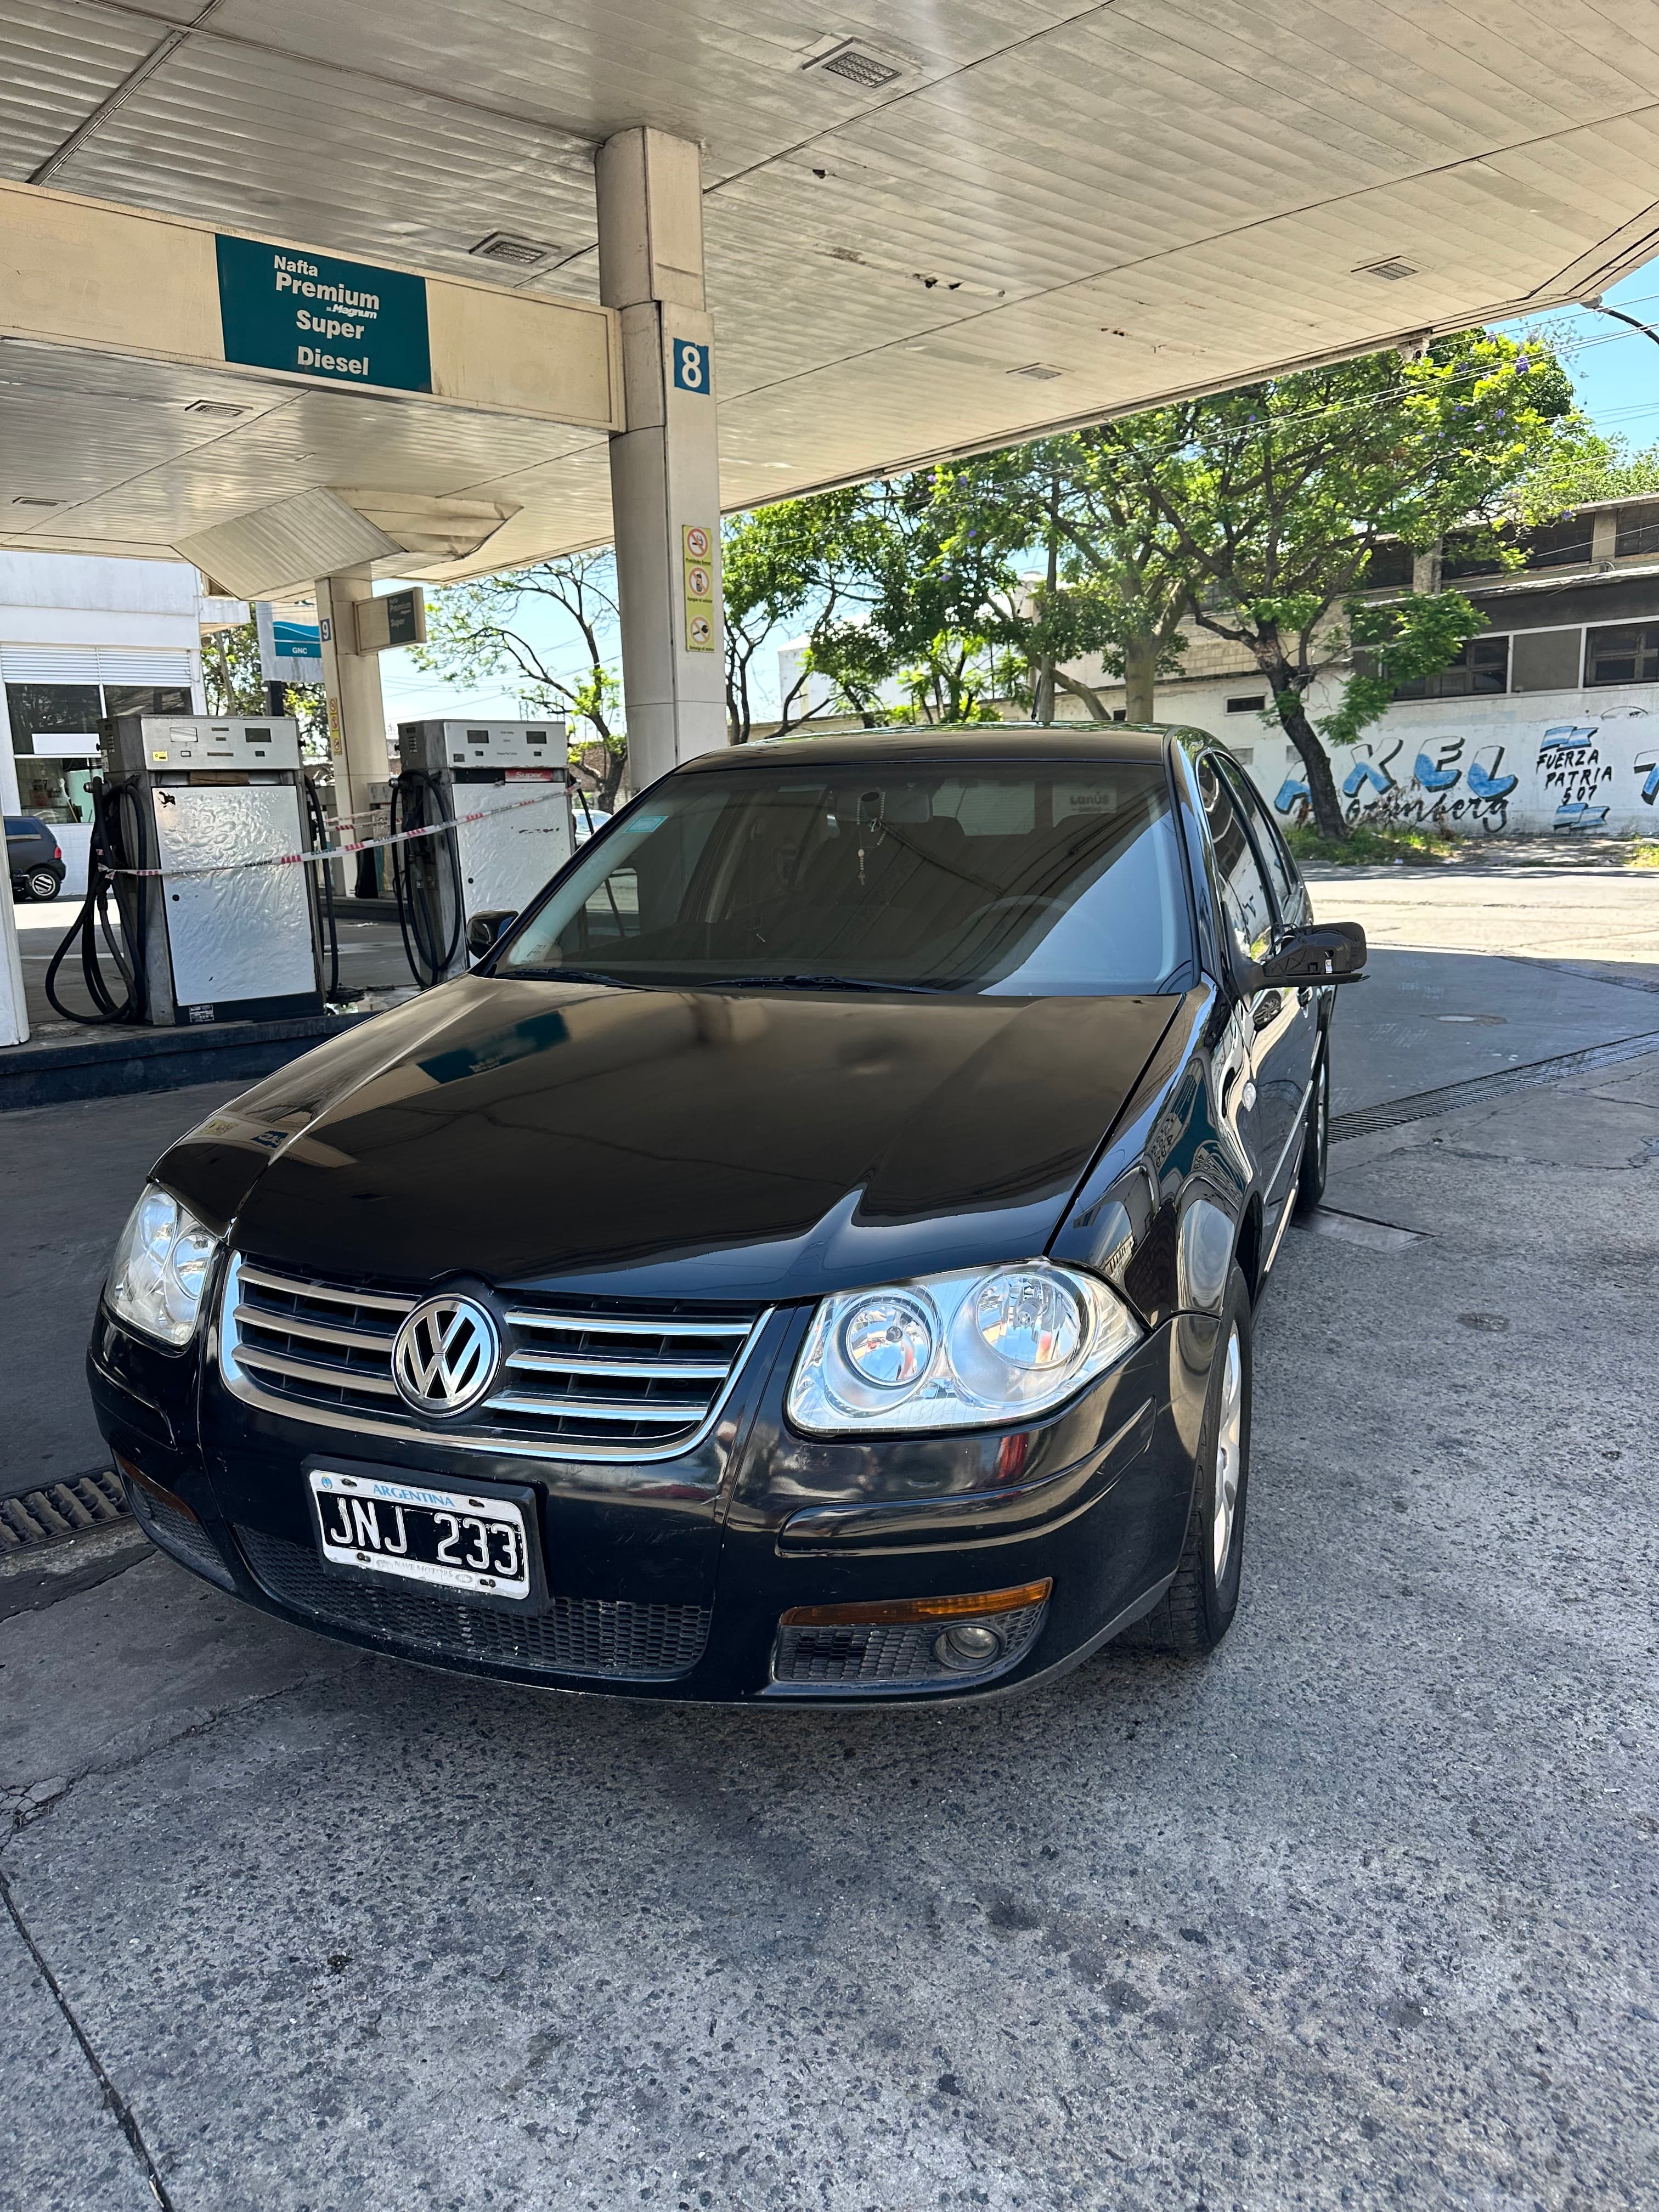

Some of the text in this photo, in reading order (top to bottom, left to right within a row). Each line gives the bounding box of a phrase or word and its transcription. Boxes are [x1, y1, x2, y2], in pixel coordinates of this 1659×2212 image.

[274, 255, 318, 277] Nafta
[275, 272, 380, 309] Premium
[296, 309, 364, 339] Super
[332, 304, 377, 319] Magnum
[297, 346, 369, 375] Diesel
[681, 345, 702, 388] 8
[322, 620, 329, 640] 9
[1536, 749, 1599, 774] FUERZA
[516, 771, 543, 780] Super
[1544, 766, 1612, 791] PATRIA
[1562, 785, 1598, 805] 507
[373, 1483, 456, 1508] ARGENTINA
[330, 1497, 518, 1575] JNJ 233
